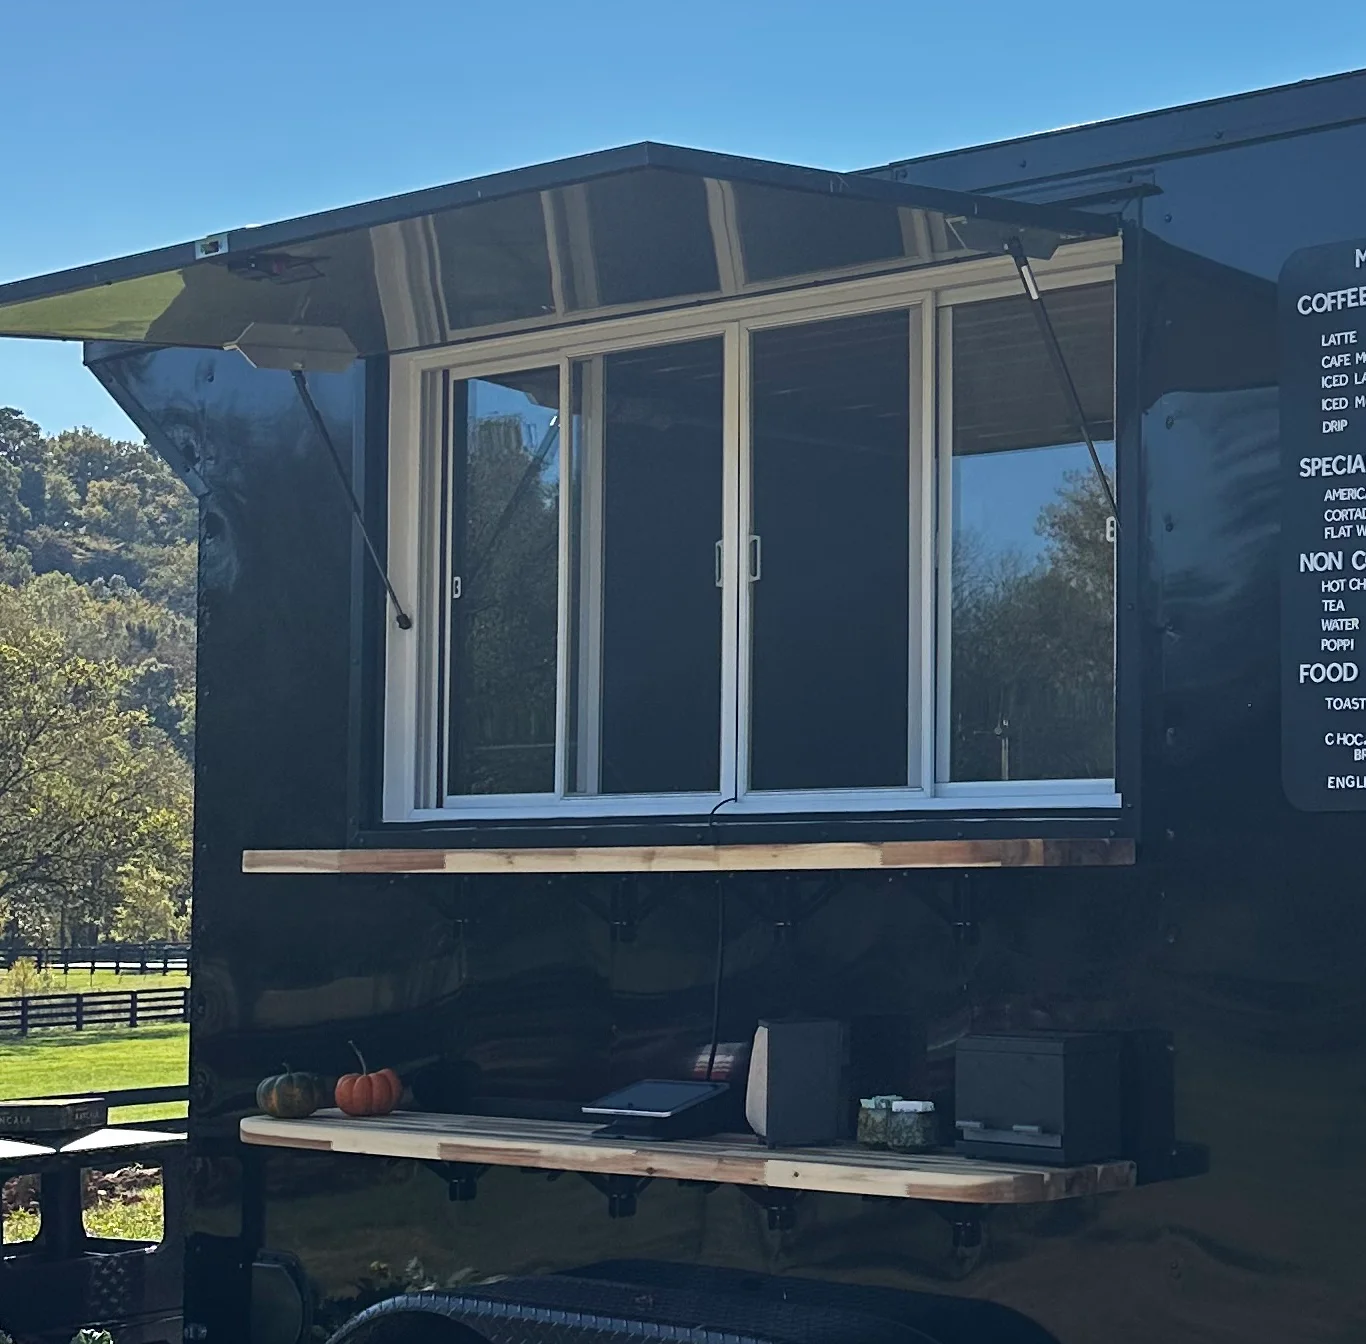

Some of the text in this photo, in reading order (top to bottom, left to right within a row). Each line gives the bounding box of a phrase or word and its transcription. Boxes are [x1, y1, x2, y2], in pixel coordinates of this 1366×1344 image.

[1322, 331, 1357, 346] LATTE
[1322, 354, 1351, 368] CAFE
[1322, 374, 1348, 388] ICED
[1322, 398, 1348, 411] ICED
[1323, 420, 1347, 433] DRIP
[1325, 525, 1353, 539] FLAT
[1300, 551, 1343, 572] NON
[1322, 579, 1346, 592] HOT
[1322, 600, 1345, 611] TEA
[1321, 618, 1359, 631] WATER
[1321, 639, 1354, 651] POPPI
[1300, 663, 1358, 683] FOOD
[1325, 698, 1366, 710] TOAST
